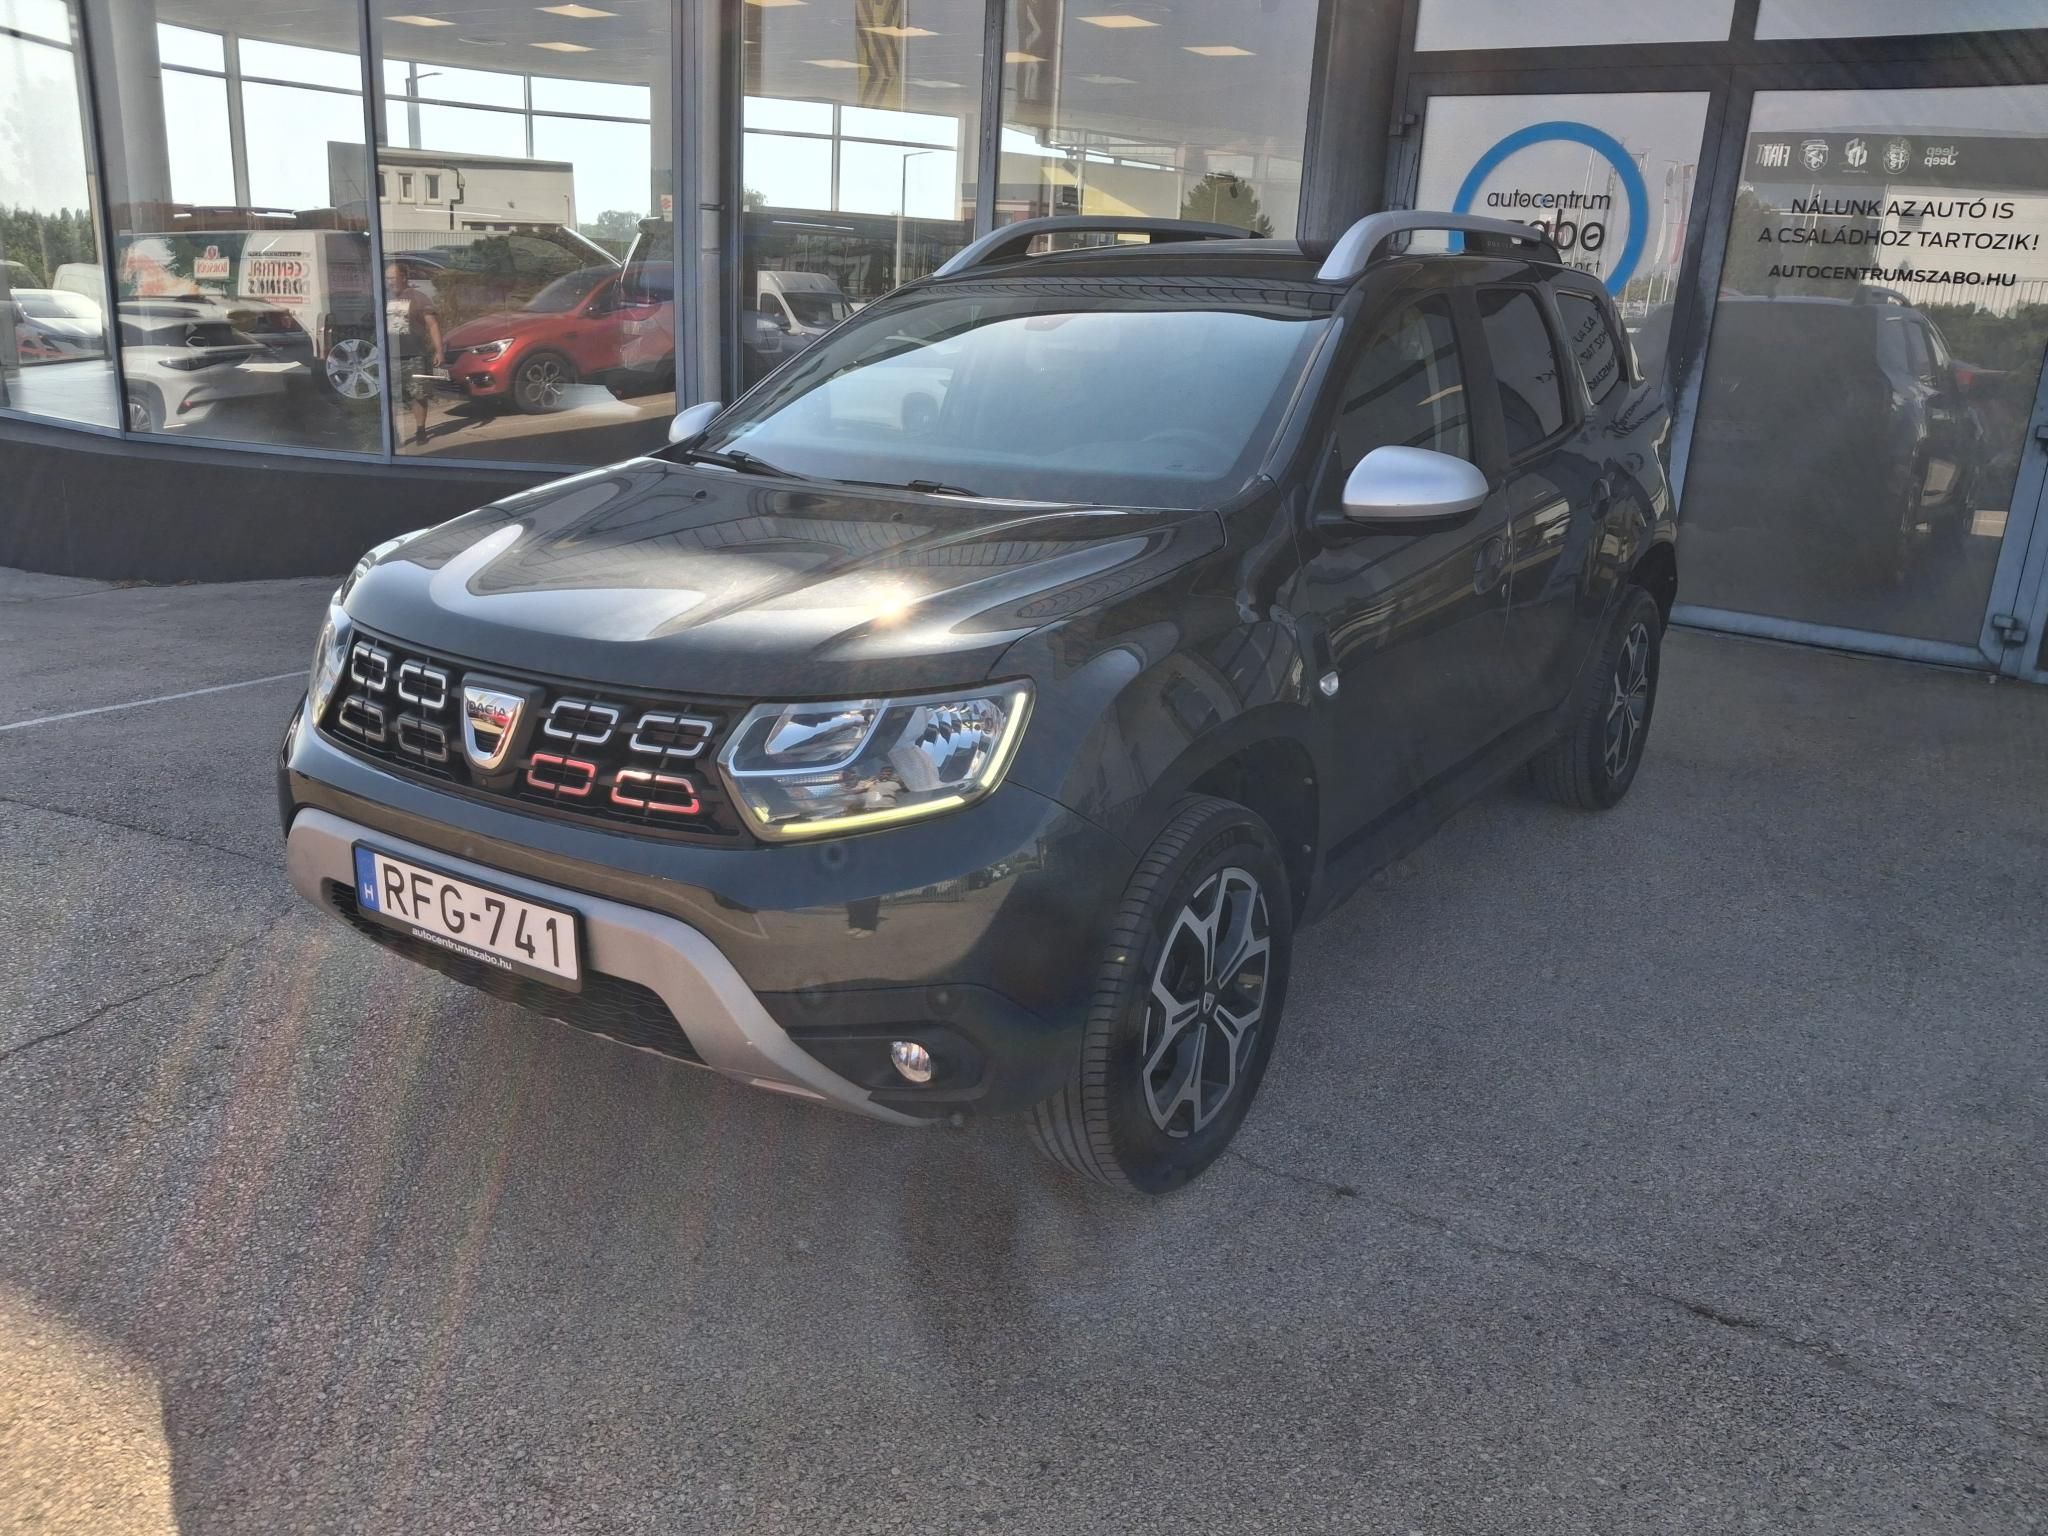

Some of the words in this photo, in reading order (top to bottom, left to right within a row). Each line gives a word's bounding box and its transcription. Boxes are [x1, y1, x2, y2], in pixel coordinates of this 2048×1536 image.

[1487, 189, 1611, 210] autocentrum
[1791, 194, 1882, 217] NÁLUNK
[1886, 200, 1916, 217] AZ
[1920, 197, 1986, 219] AUTÓ
[1992, 202, 2016, 219] IS
[1758, 227, 1773, 243] A
[1778, 224, 1912, 247] CSALÁDHOZ
[1918, 231, 2040, 251] TARTOZIK!
[1768, 264, 2017, 287] AUTOCENTRUMSZABO.HU
[468, 700, 506, 716] DACIA
[365, 882, 373, 899] H
[382, 862, 561, 969] RFG-741
[411, 926, 513, 971] autocentrumszabo.hu
